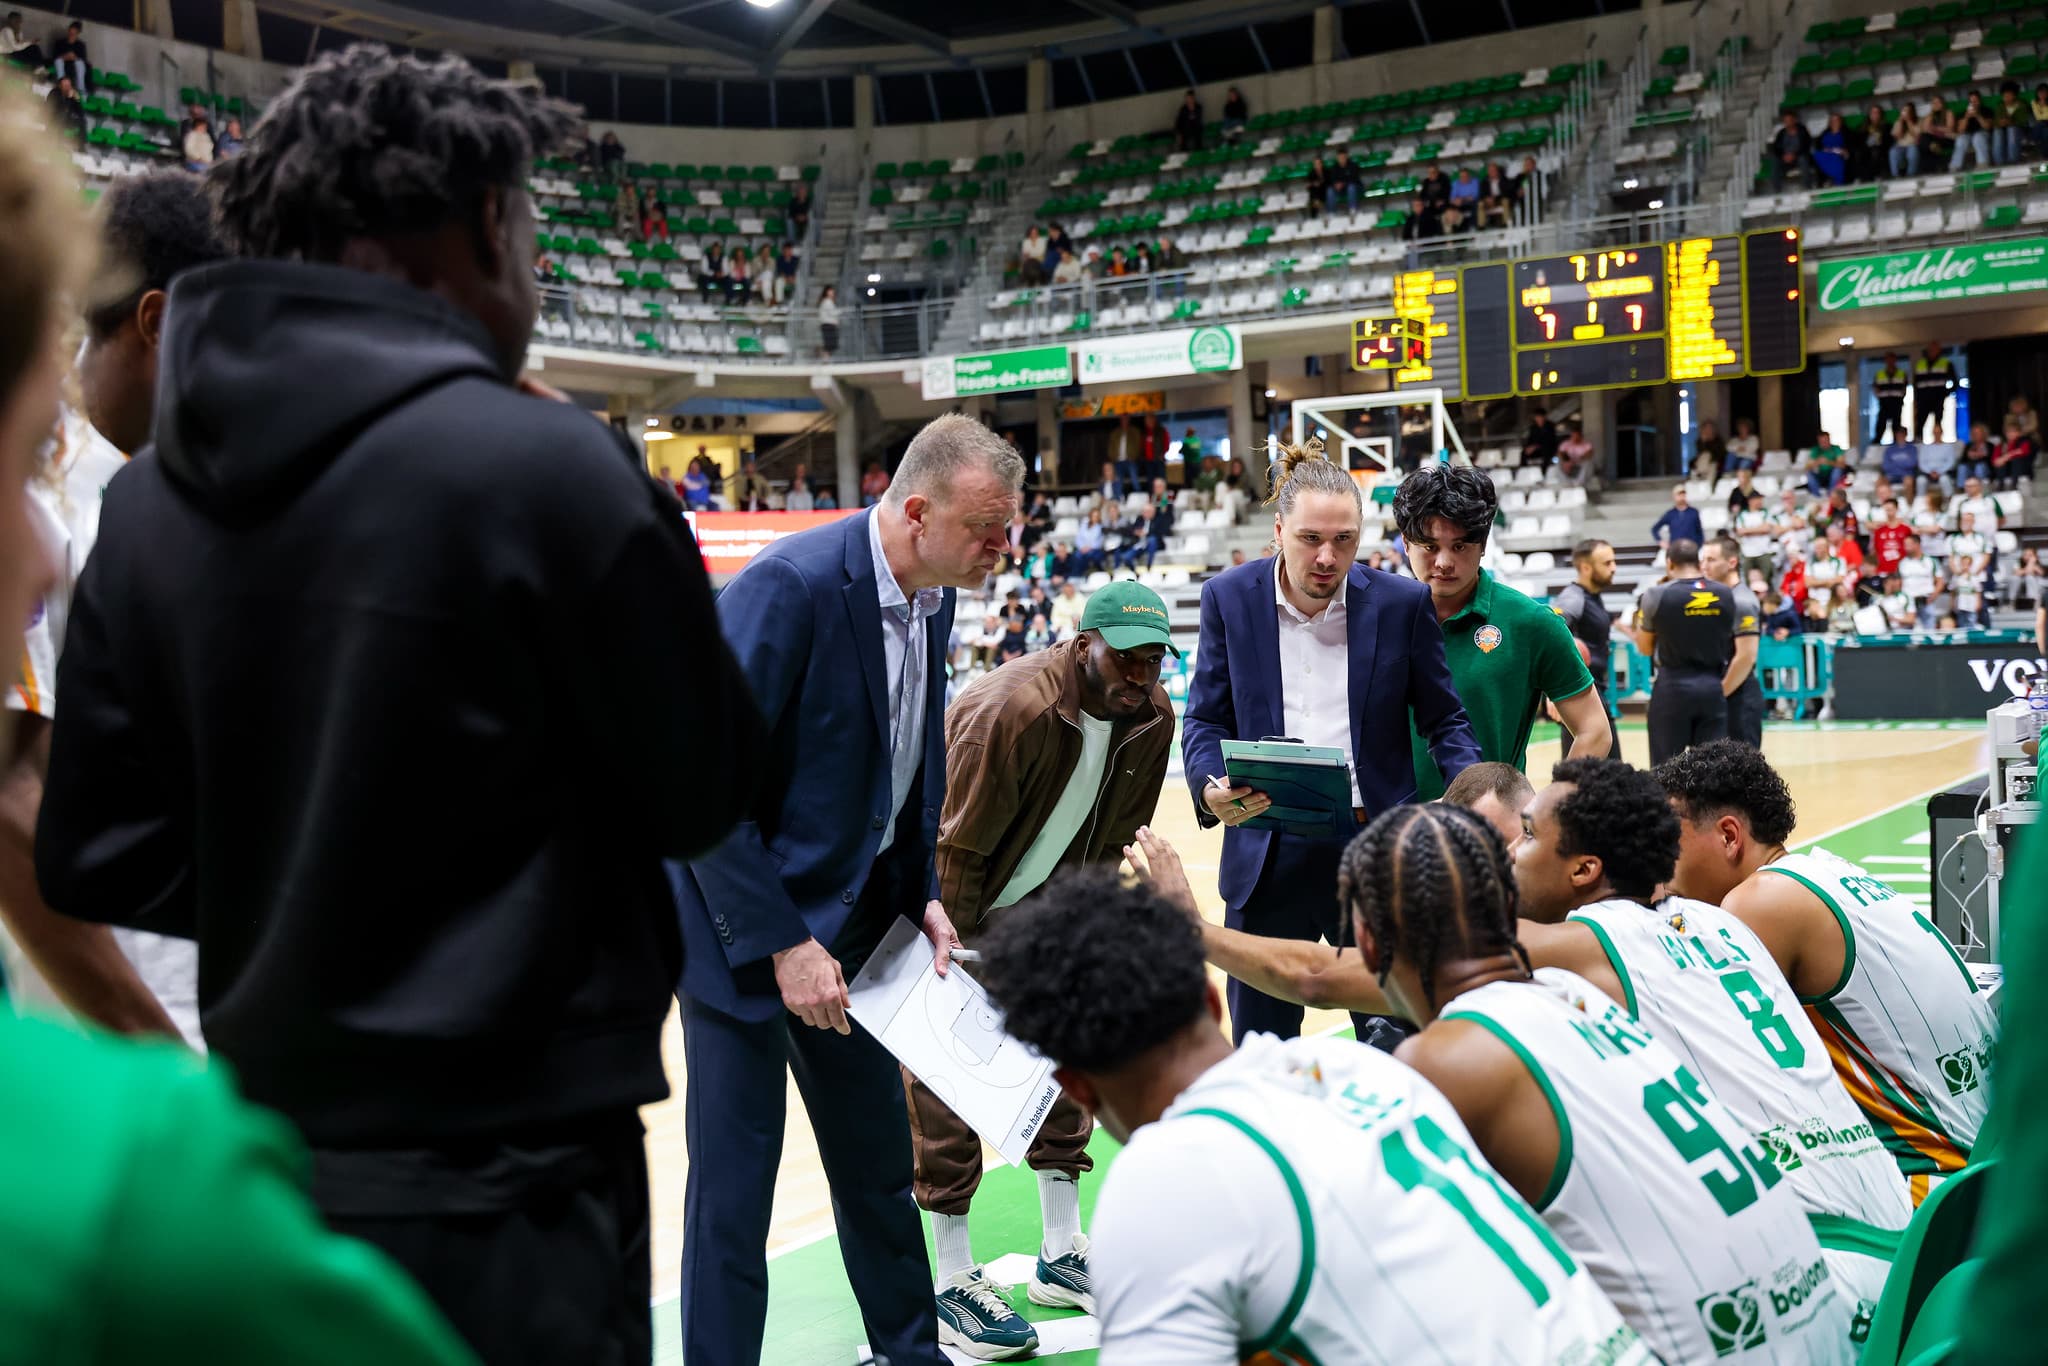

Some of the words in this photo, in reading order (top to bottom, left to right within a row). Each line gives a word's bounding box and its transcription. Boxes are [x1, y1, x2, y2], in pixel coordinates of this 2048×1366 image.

[1122, 604, 1151, 614] Maybe
[1718, 970, 1806, 1069] 8
[1020, 1085, 1056, 1141] fiba.basketball
[1380, 1114, 1577, 1308] 11
